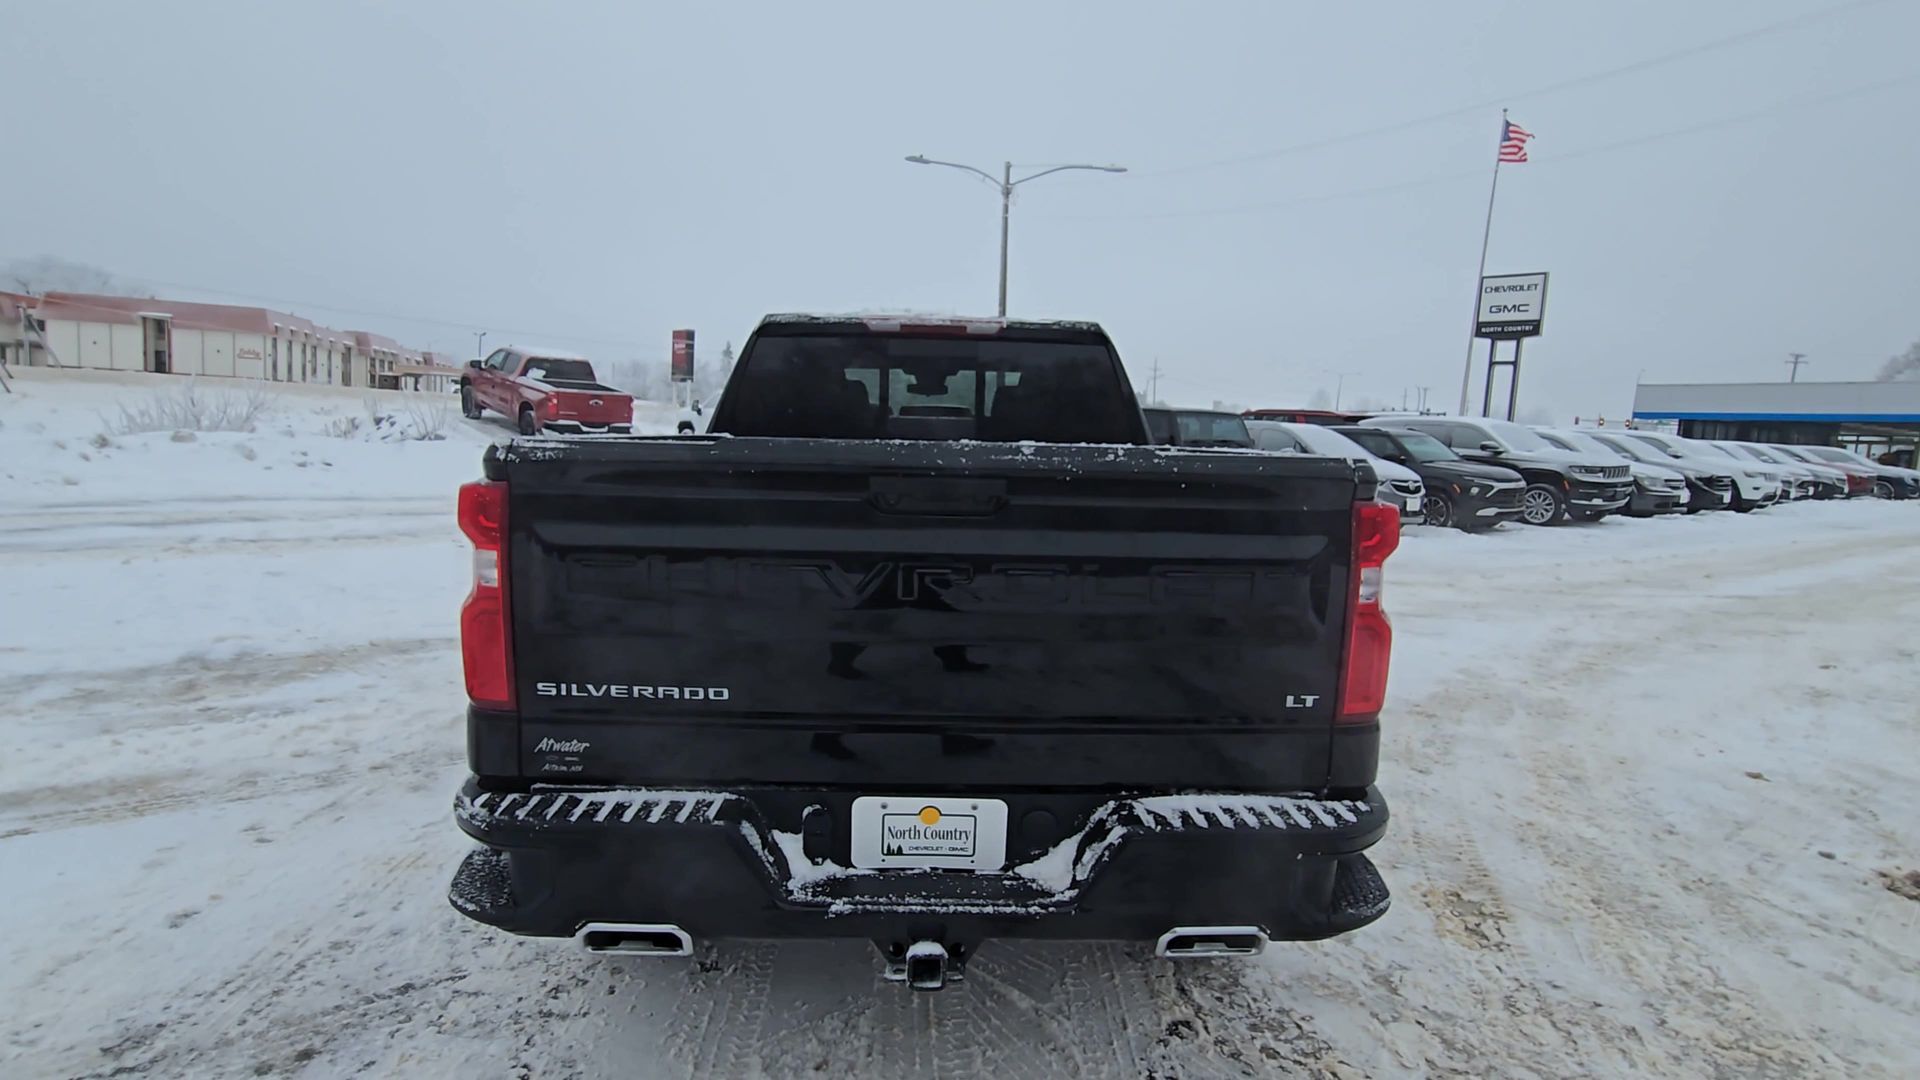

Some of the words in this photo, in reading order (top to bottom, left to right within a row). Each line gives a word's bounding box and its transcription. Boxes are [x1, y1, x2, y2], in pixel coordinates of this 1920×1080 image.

[1484, 283, 1539, 294] CHEVROLET
[1489, 303, 1530, 314] GMC
[536, 682, 730, 700] SILVERADO
[1285, 695, 1320, 708] LT
[534, 736, 590, 753] Atwater
[887, 824, 921, 841] North
[923, 826, 972, 844] Country
[948, 845, 969, 853] GMC
